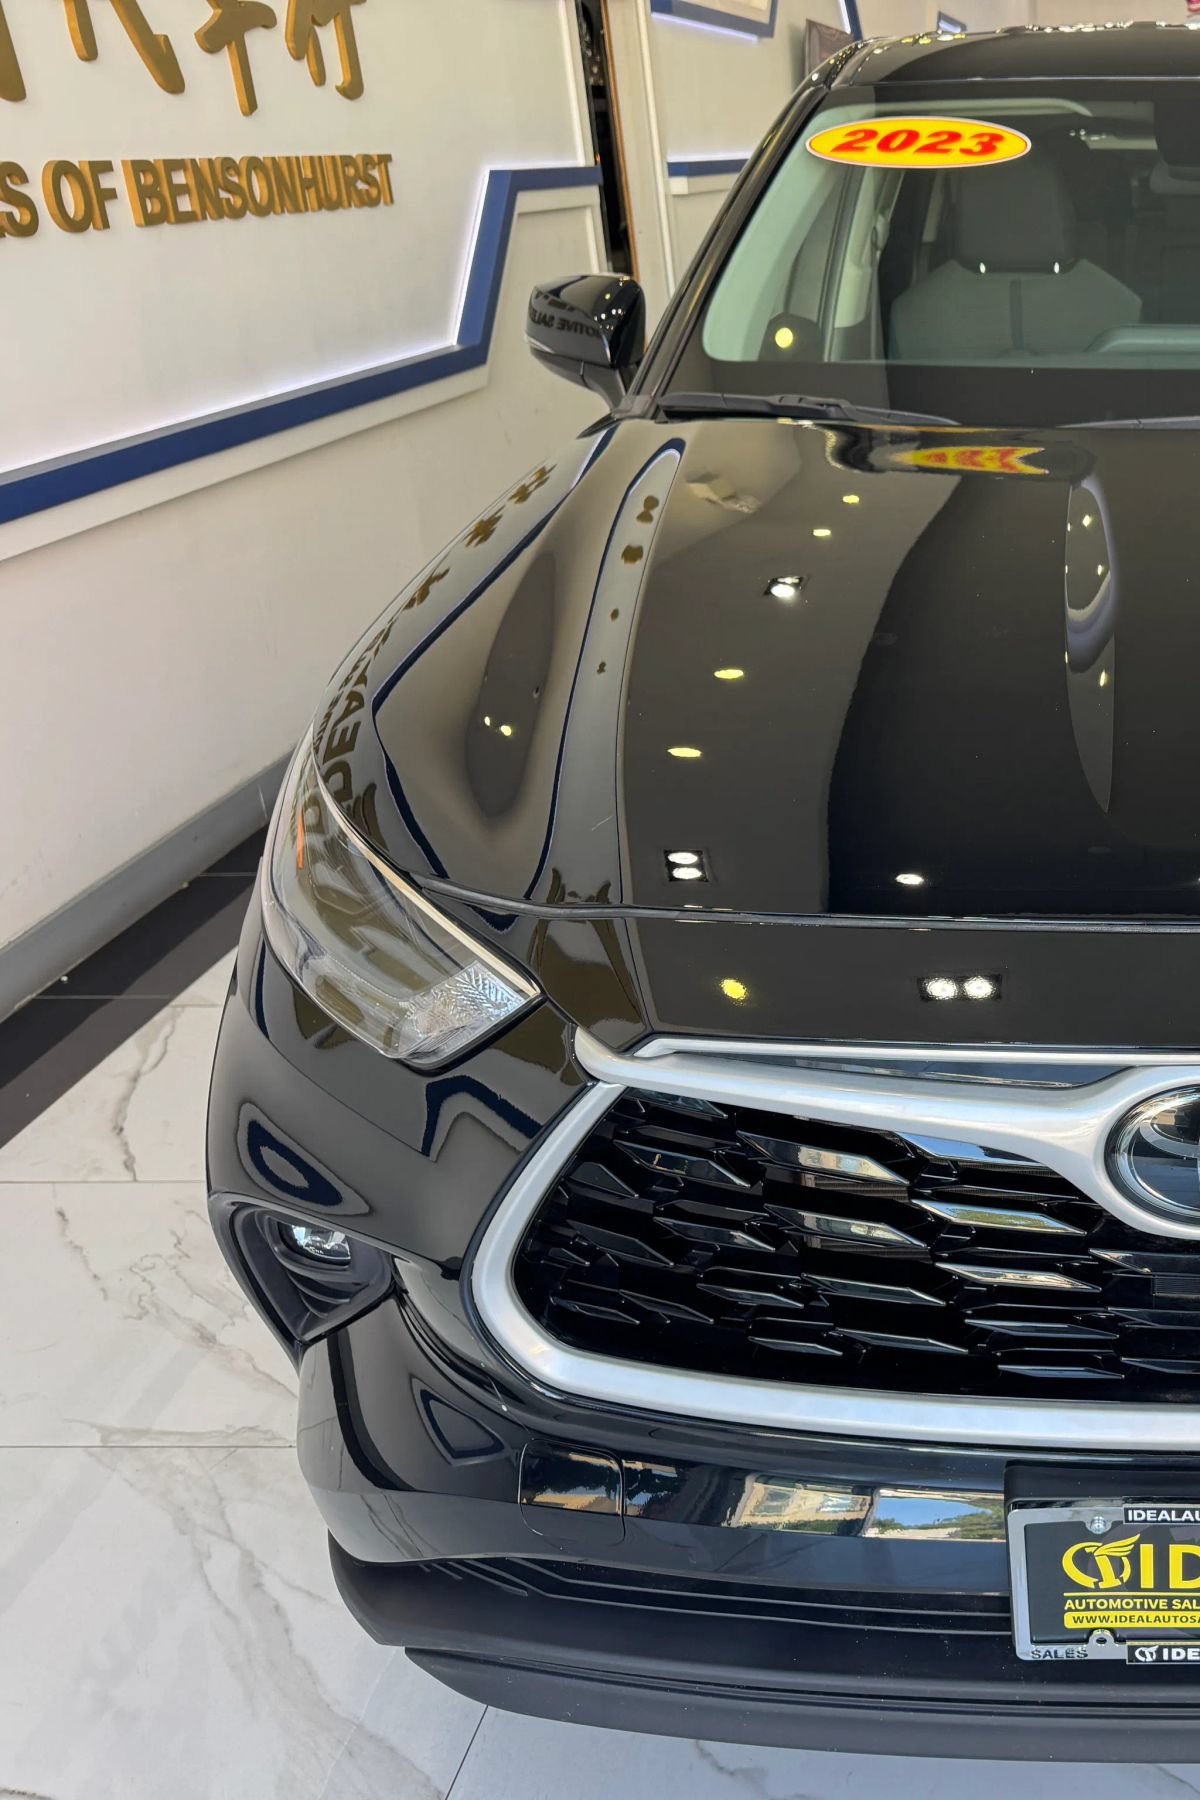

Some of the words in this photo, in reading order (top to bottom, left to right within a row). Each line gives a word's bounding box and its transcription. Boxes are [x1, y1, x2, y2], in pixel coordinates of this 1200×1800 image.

[831, 129, 1004, 156] 2023
[42, 160, 118, 233] OF
[121, 154, 394, 228] BENSONHURST
[1064, 1598, 1168, 1610] AUTOMOTIVE
[1031, 1648, 1088, 1660] SALES
